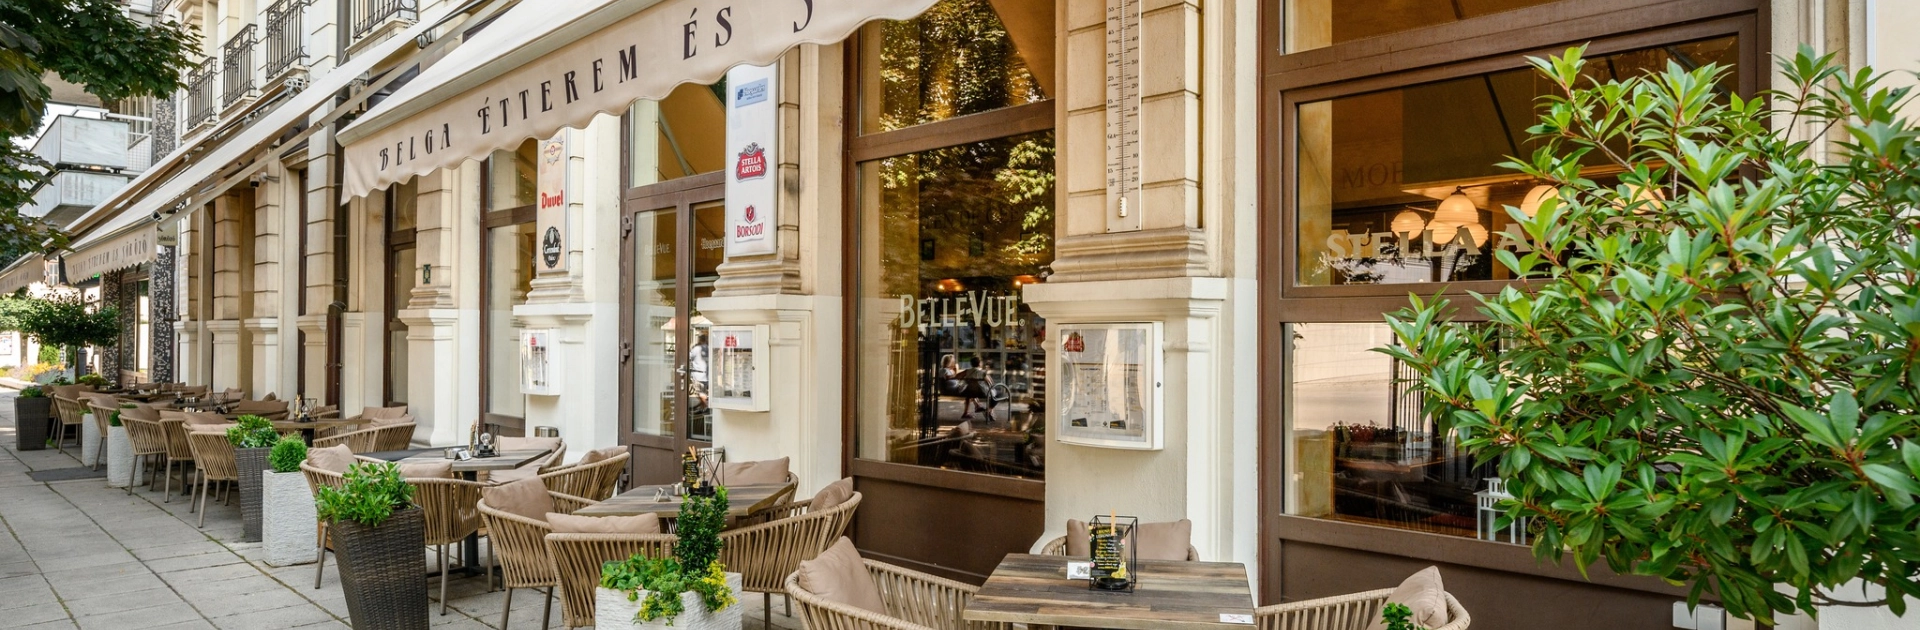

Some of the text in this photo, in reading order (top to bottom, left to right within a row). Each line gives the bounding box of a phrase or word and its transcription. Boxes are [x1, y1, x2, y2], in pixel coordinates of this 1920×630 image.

[380, 123, 451, 171] BELGA
[478, 44, 638, 136] ÉTTEREM
[684, 5, 733, 60] ÉS
[741, 157, 761, 167] STELLA
[741, 164, 762, 175] ARTOIS
[541, 189, 564, 209] Duvel
[736, 222, 764, 238] BORSODI
[1326, 225, 1482, 261] STELLA
